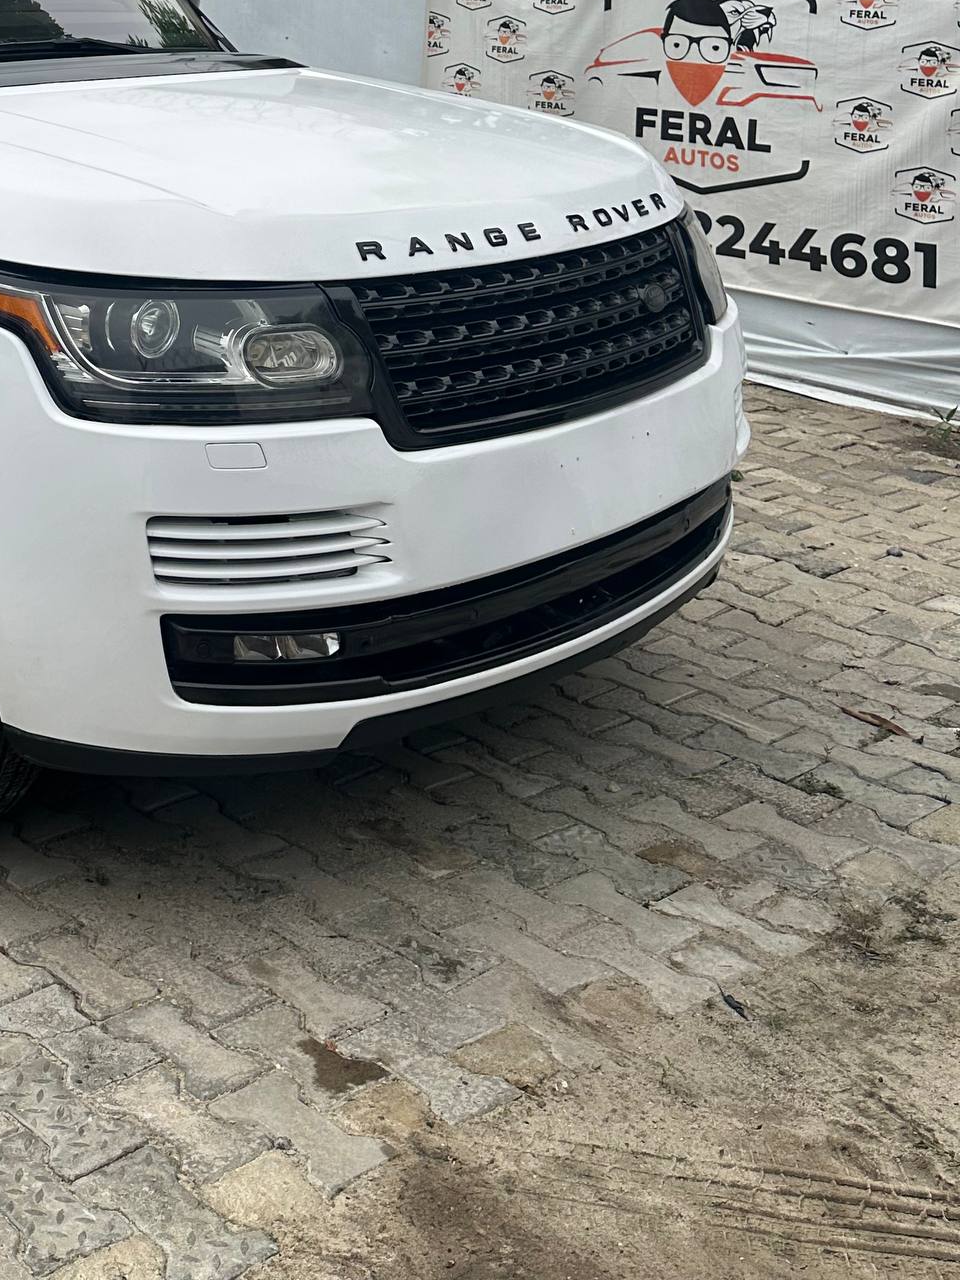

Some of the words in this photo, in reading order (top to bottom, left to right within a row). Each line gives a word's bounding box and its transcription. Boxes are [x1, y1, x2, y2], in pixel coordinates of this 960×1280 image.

[849, 9, 887, 19] FERAL
[491, 45, 519, 55] FERAL
[910, 77, 950, 89] FERAL
[535, 100, 567, 111] FERAL
[635, 106, 772, 153] FERAL
[843, 131, 881, 144] FERAL
[663, 146, 740, 173] AUTOS
[904, 202, 945, 215] FERAL
[355, 222, 542, 261] RANGE
[565, 192, 667, 232] ROVER
